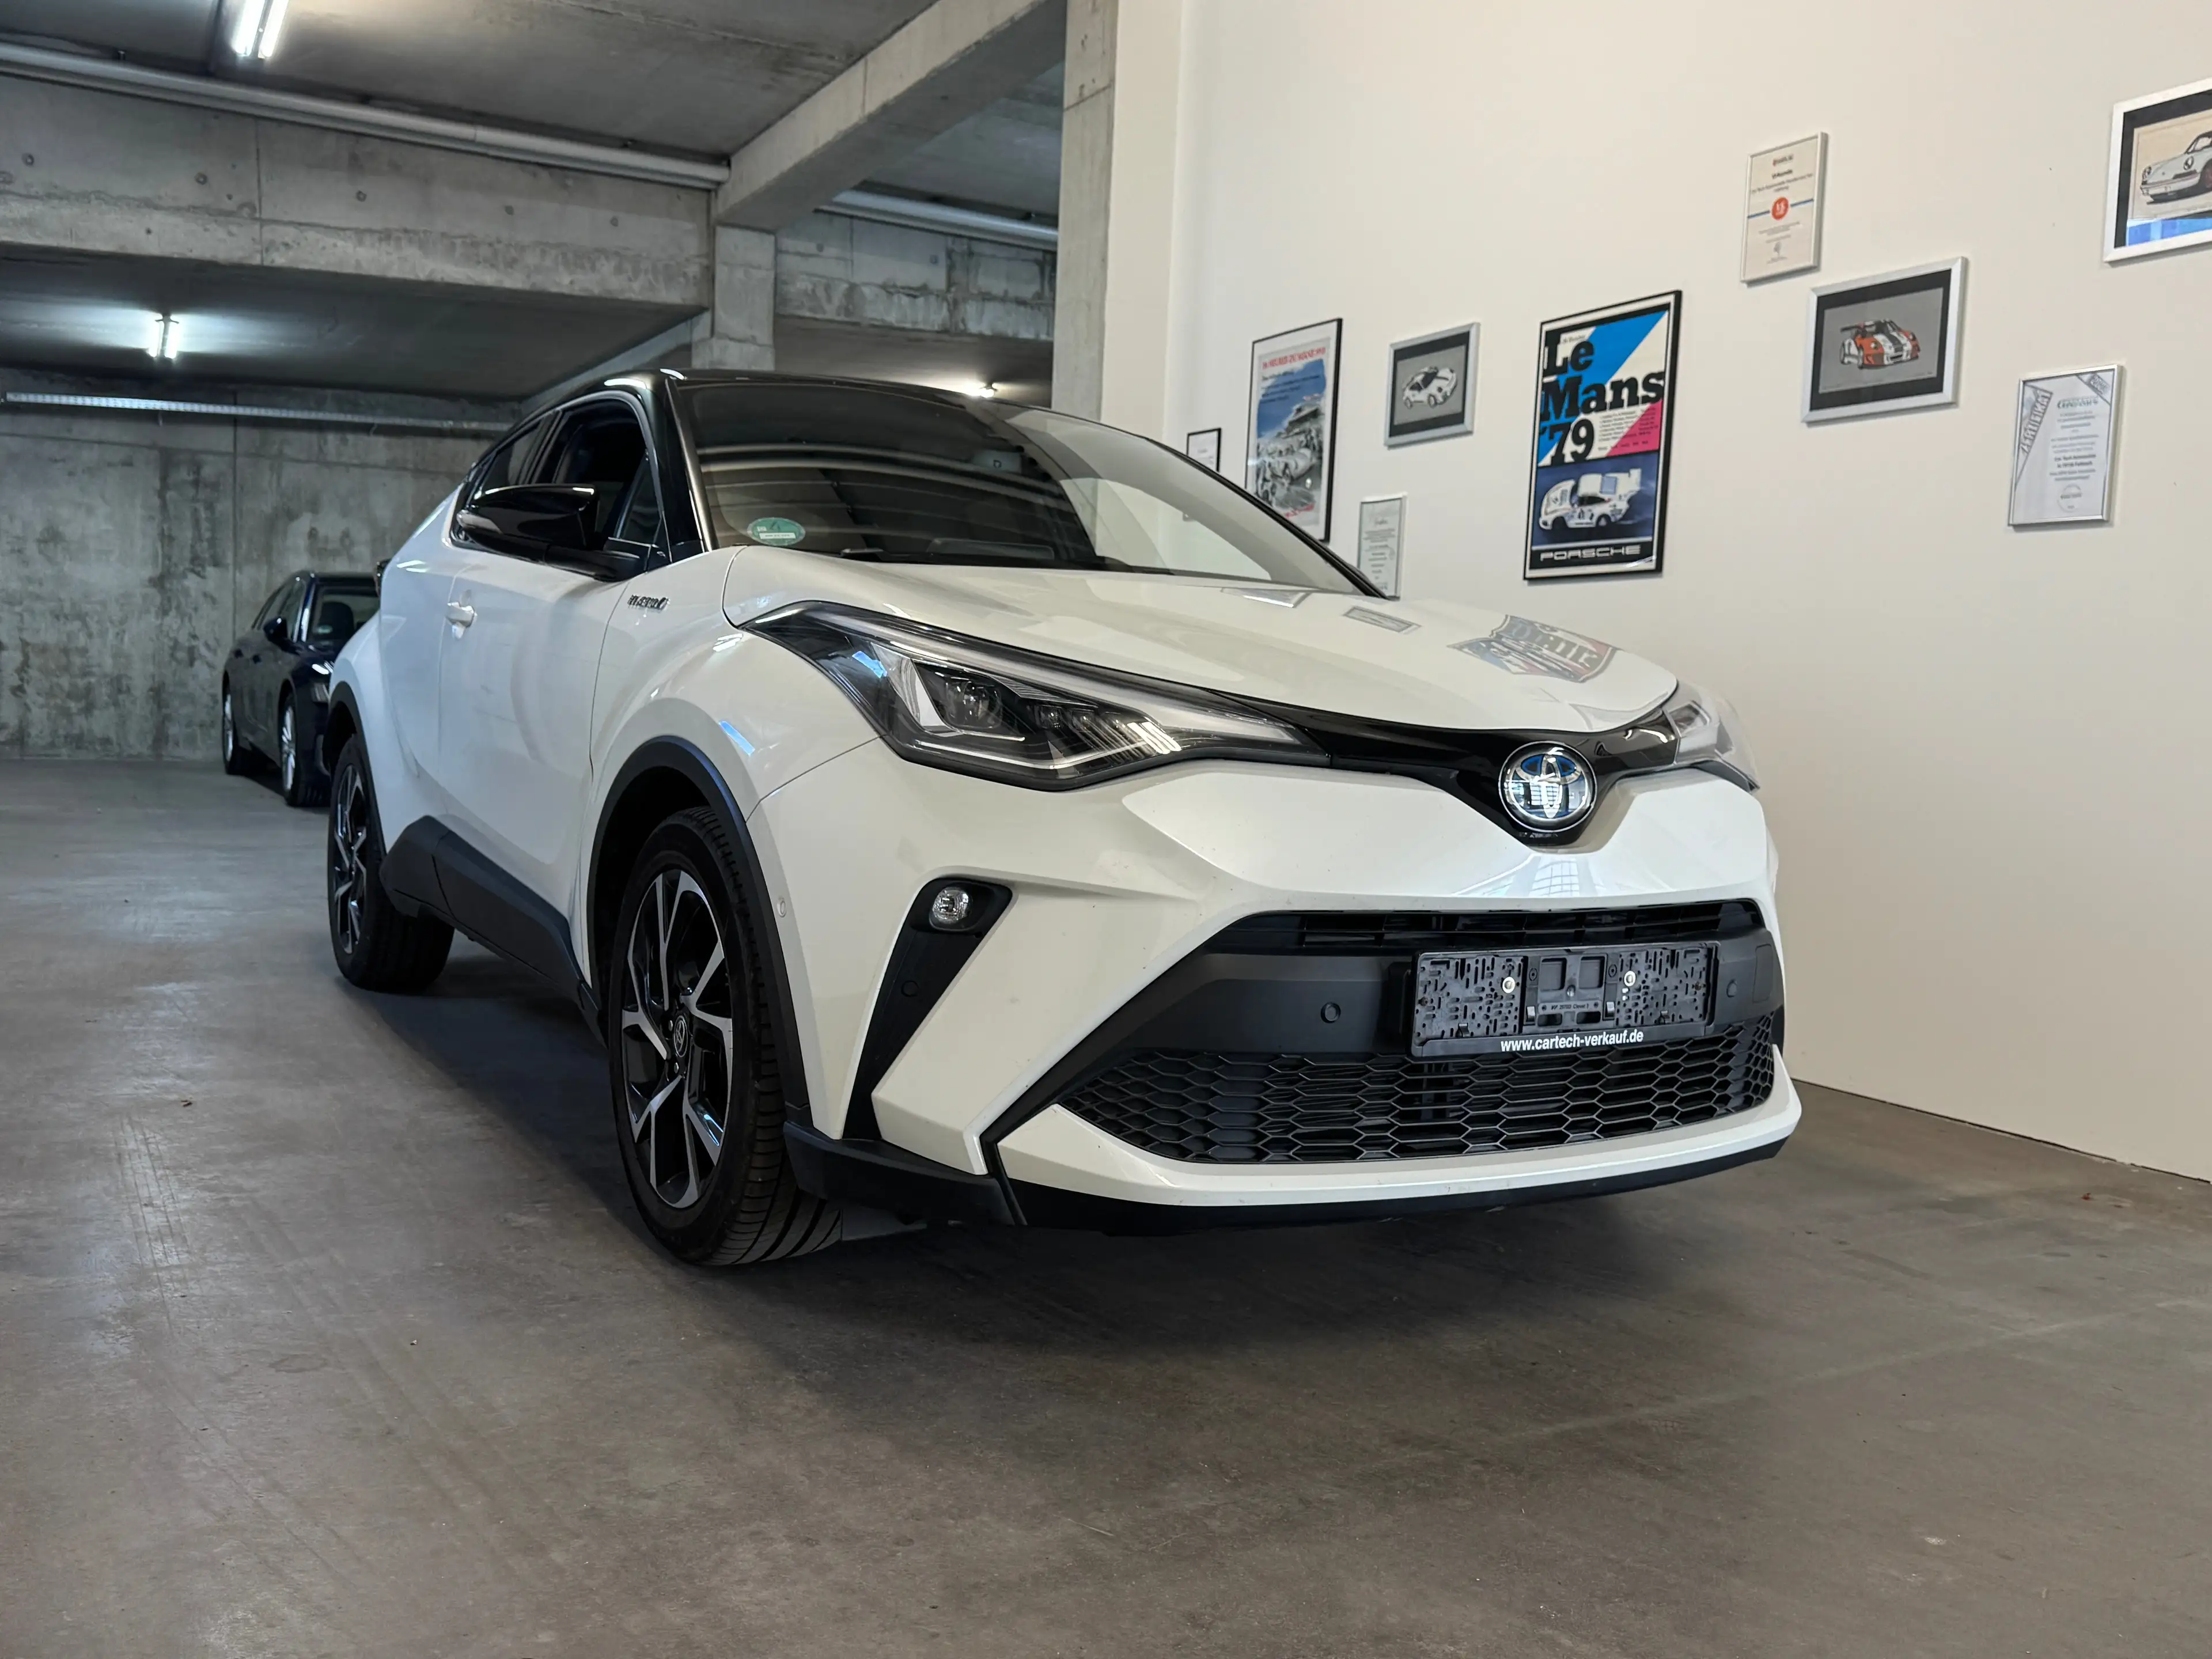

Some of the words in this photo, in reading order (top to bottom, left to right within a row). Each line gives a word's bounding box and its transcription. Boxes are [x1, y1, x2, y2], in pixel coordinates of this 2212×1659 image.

[1543, 332, 1594, 376] Le
[1540, 370, 1666, 422] Mans
[1539, 418, 1594, 465] '79
[1540, 544, 1641, 562] PORSCHE
[1500, 1028, 1644, 1052] www.cartech-verkauf.de
